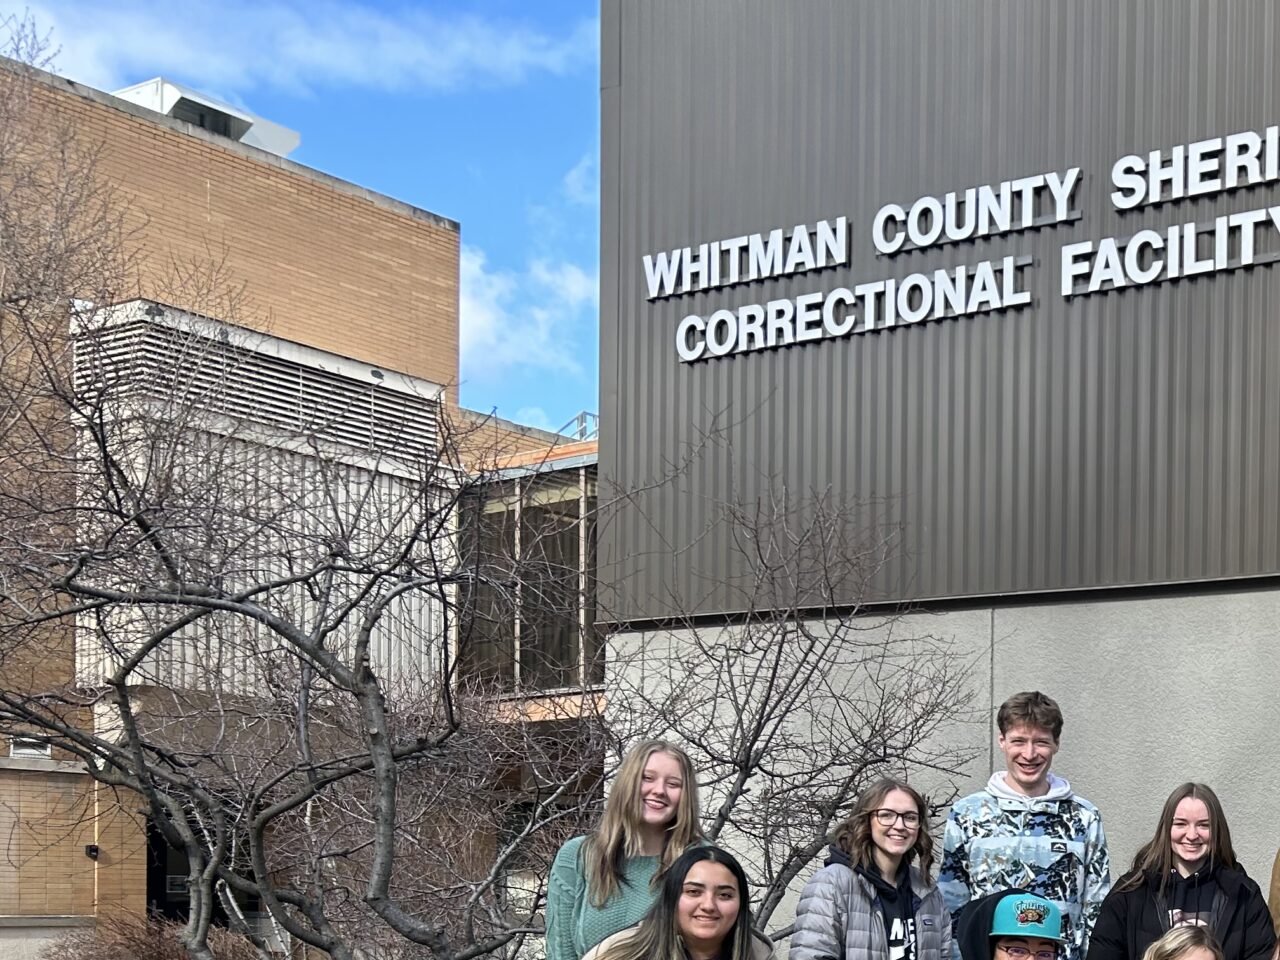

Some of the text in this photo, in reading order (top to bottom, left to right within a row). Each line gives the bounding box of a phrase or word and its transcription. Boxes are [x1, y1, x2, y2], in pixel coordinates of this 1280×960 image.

[643, 217, 848, 299] WHITMAN
[872, 168, 1081, 255] COUNTY
[675, 256, 1031, 362] CORRECTIONAL
